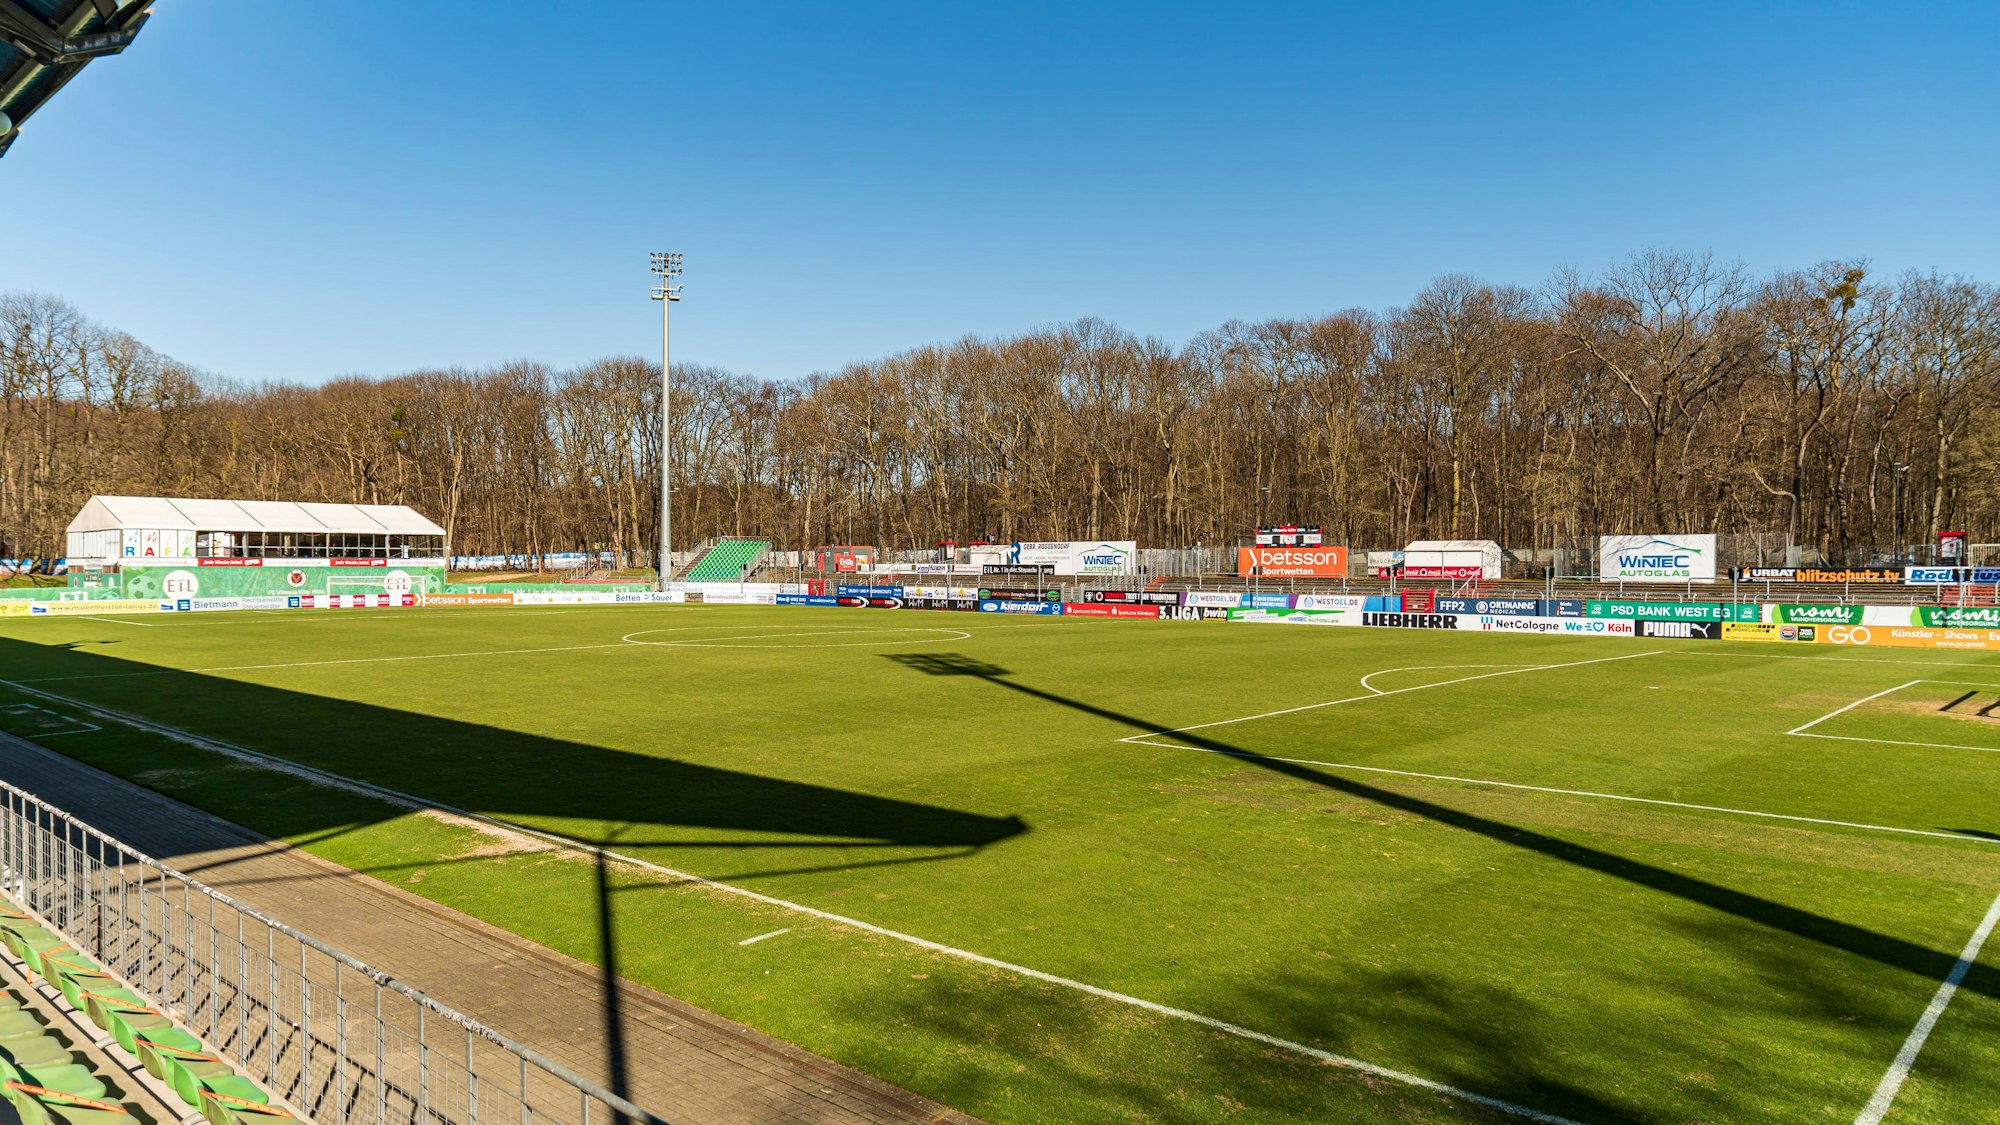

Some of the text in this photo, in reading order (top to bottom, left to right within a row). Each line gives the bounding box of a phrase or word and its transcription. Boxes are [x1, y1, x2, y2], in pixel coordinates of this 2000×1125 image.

[1261, 549, 1337, 565] betsson
[1262, 567, 1314, 576] Sportwetten
[1752, 569, 1795, 577] URBAT
[1796, 569, 1900, 583] blitzschutz.tv
[168, 579, 194, 593] ETL
[615, 594, 673, 602] Betten Sauer
[1316, 598, 1359, 606] WESTOEL.DE
[194, 601, 238, 609] Bietmann
[1000, 601, 1049, 611] kierdorf
[1440, 601, 1465, 611] FFP2
[1158, 606, 1170, 620] 3.
[1203, 607, 1227, 618] bwin
[1610, 605, 1731, 618] PSD BANK WEST EG
[1362, 613, 1458, 629] LIEBHERR
[1496, 620, 1559, 632] NetCologne
[1565, 622, 1632, 632] We Köln
[1828, 625, 1872, 645] GO
[1891, 629, 1934, 639] Künstler
[1943, 631, 1979, 640] Shows
